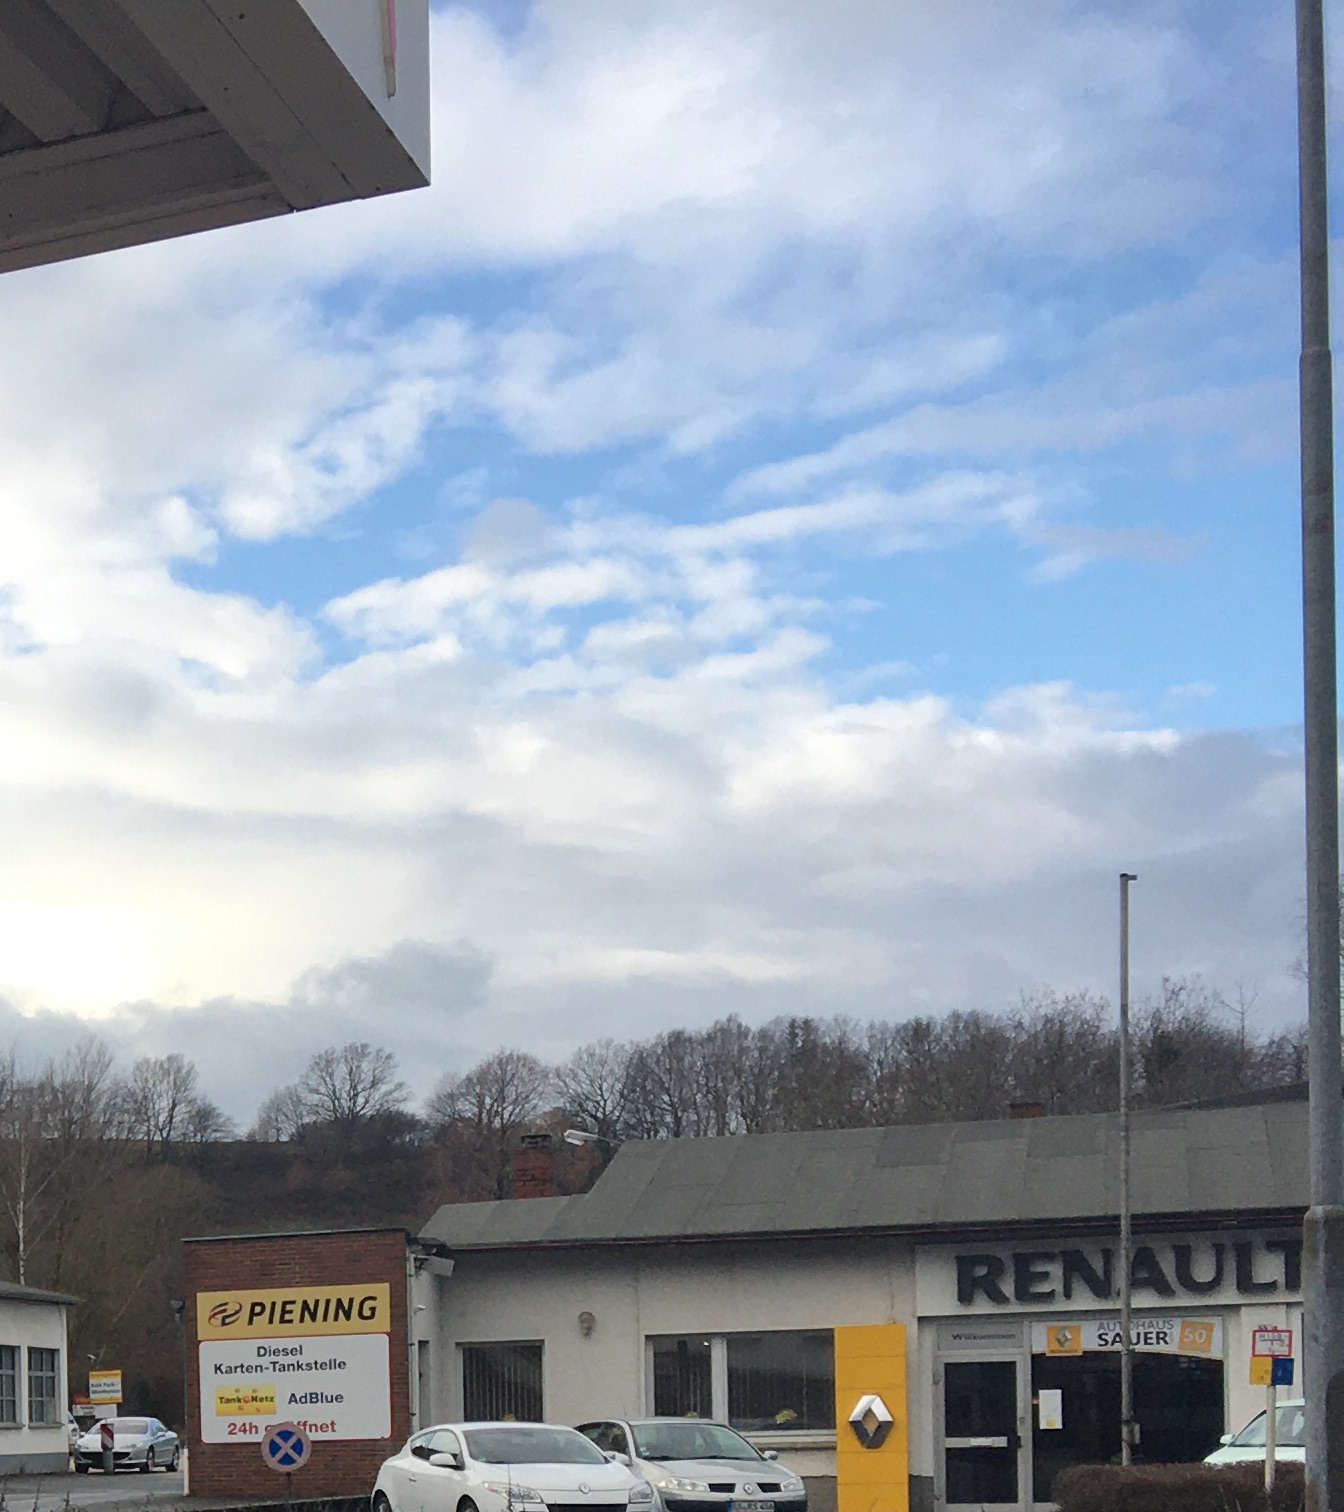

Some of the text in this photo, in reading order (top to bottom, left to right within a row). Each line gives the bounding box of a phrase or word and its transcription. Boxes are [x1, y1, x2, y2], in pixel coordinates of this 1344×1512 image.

[955, 1239, 1303, 1306] RENAULT
[247, 1295, 378, 1326] PIENING
[256, 1344, 303, 1358] Diesel
[214, 1358, 347, 1375] Karten-Tankstelle
[287, 1391, 344, 1405] AdBlue
[227, 1421, 259, 1436] 24h
